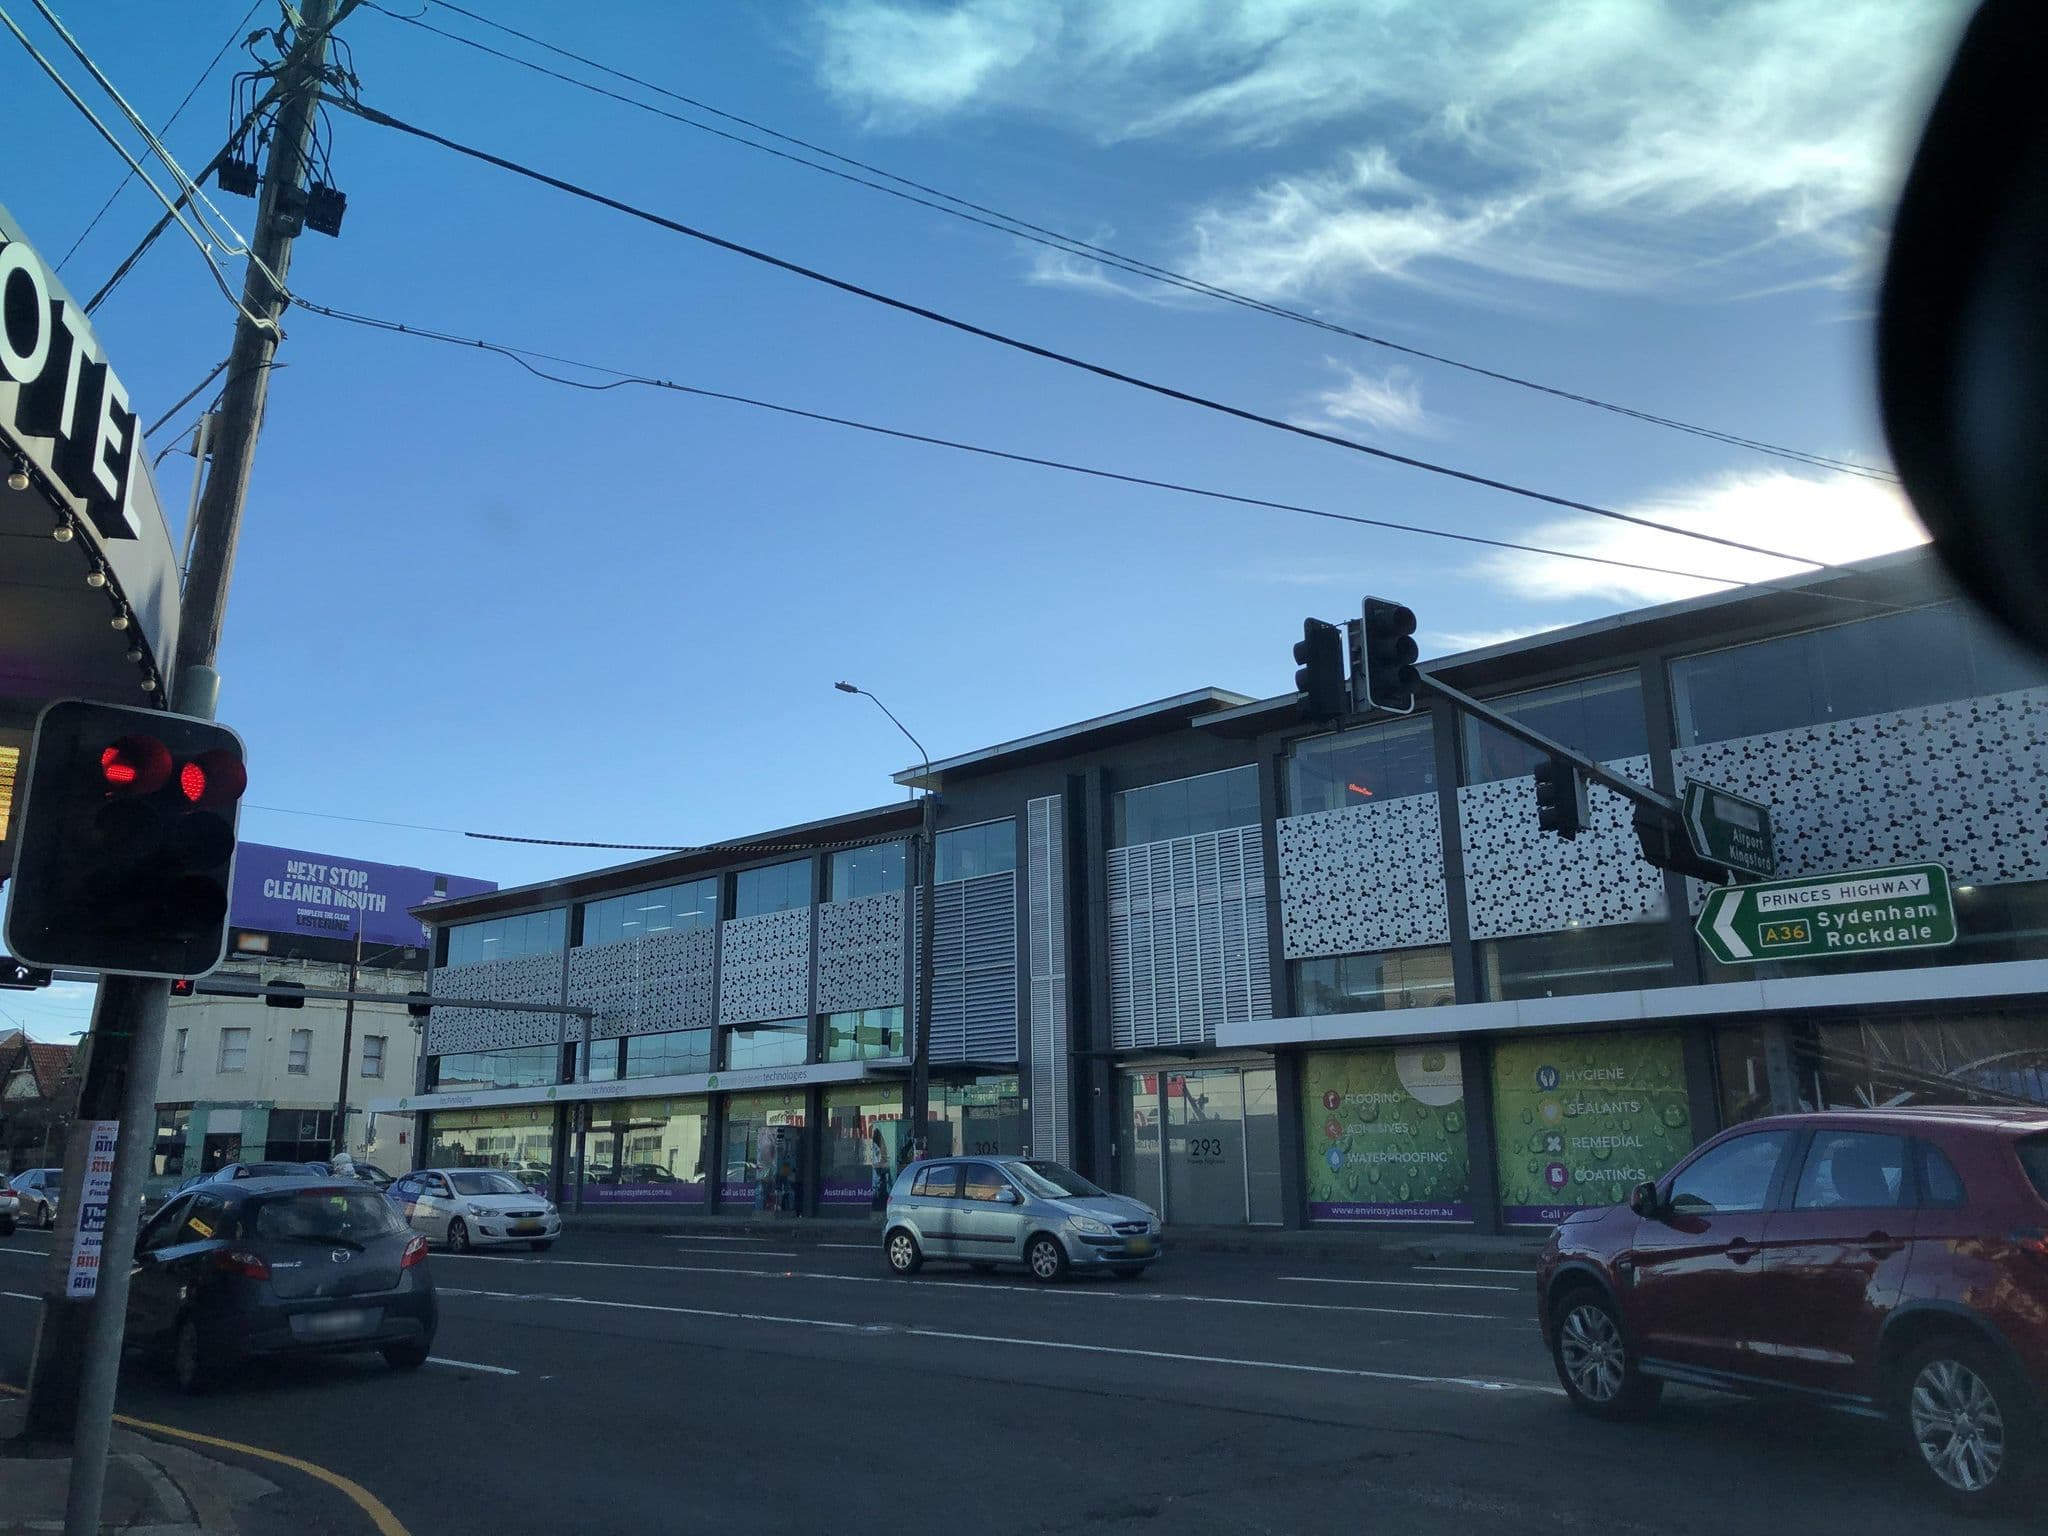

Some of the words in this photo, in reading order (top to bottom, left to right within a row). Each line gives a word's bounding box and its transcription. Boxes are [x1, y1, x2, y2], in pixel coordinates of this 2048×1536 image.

[0, 241, 141, 540] OTEL
[1733, 827, 1763, 850] Airport
[286, 860, 327, 883] NEXT
[329, 866, 369, 892] STOP,
[263, 879, 332, 905] CLEANER
[334, 888, 387, 912] MOUTH
[1762, 889, 1831, 907] PRINCES
[1840, 878, 1921, 900] HIGHWAY
[1817, 904, 1937, 930] Sydenham
[1766, 926, 1805, 941] A36
[1827, 925, 1932, 947] Rockdale
[1565, 1068, 1625, 1081] HYGIENE
[1345, 1092, 1401, 1104] FLOORING
[1567, 1101, 1641, 1116] SEALANTS
[1347, 1122, 1409, 1134] ADSIVES
[975, 1141, 999, 1155] 305
[1191, 1139, 1221, 1156] 293
[1572, 1135, 1644, 1149] REMEDIAL
[1347, 1151, 1448, 1164] WATERPROOFING
[1574, 1169, 1647, 1182] COATINGS
[824, 1188, 857, 1197] Australian
[1332, 1206, 1453, 1217] www.envirosystems.com.au
[1541, 1209, 1560, 1219] Call
